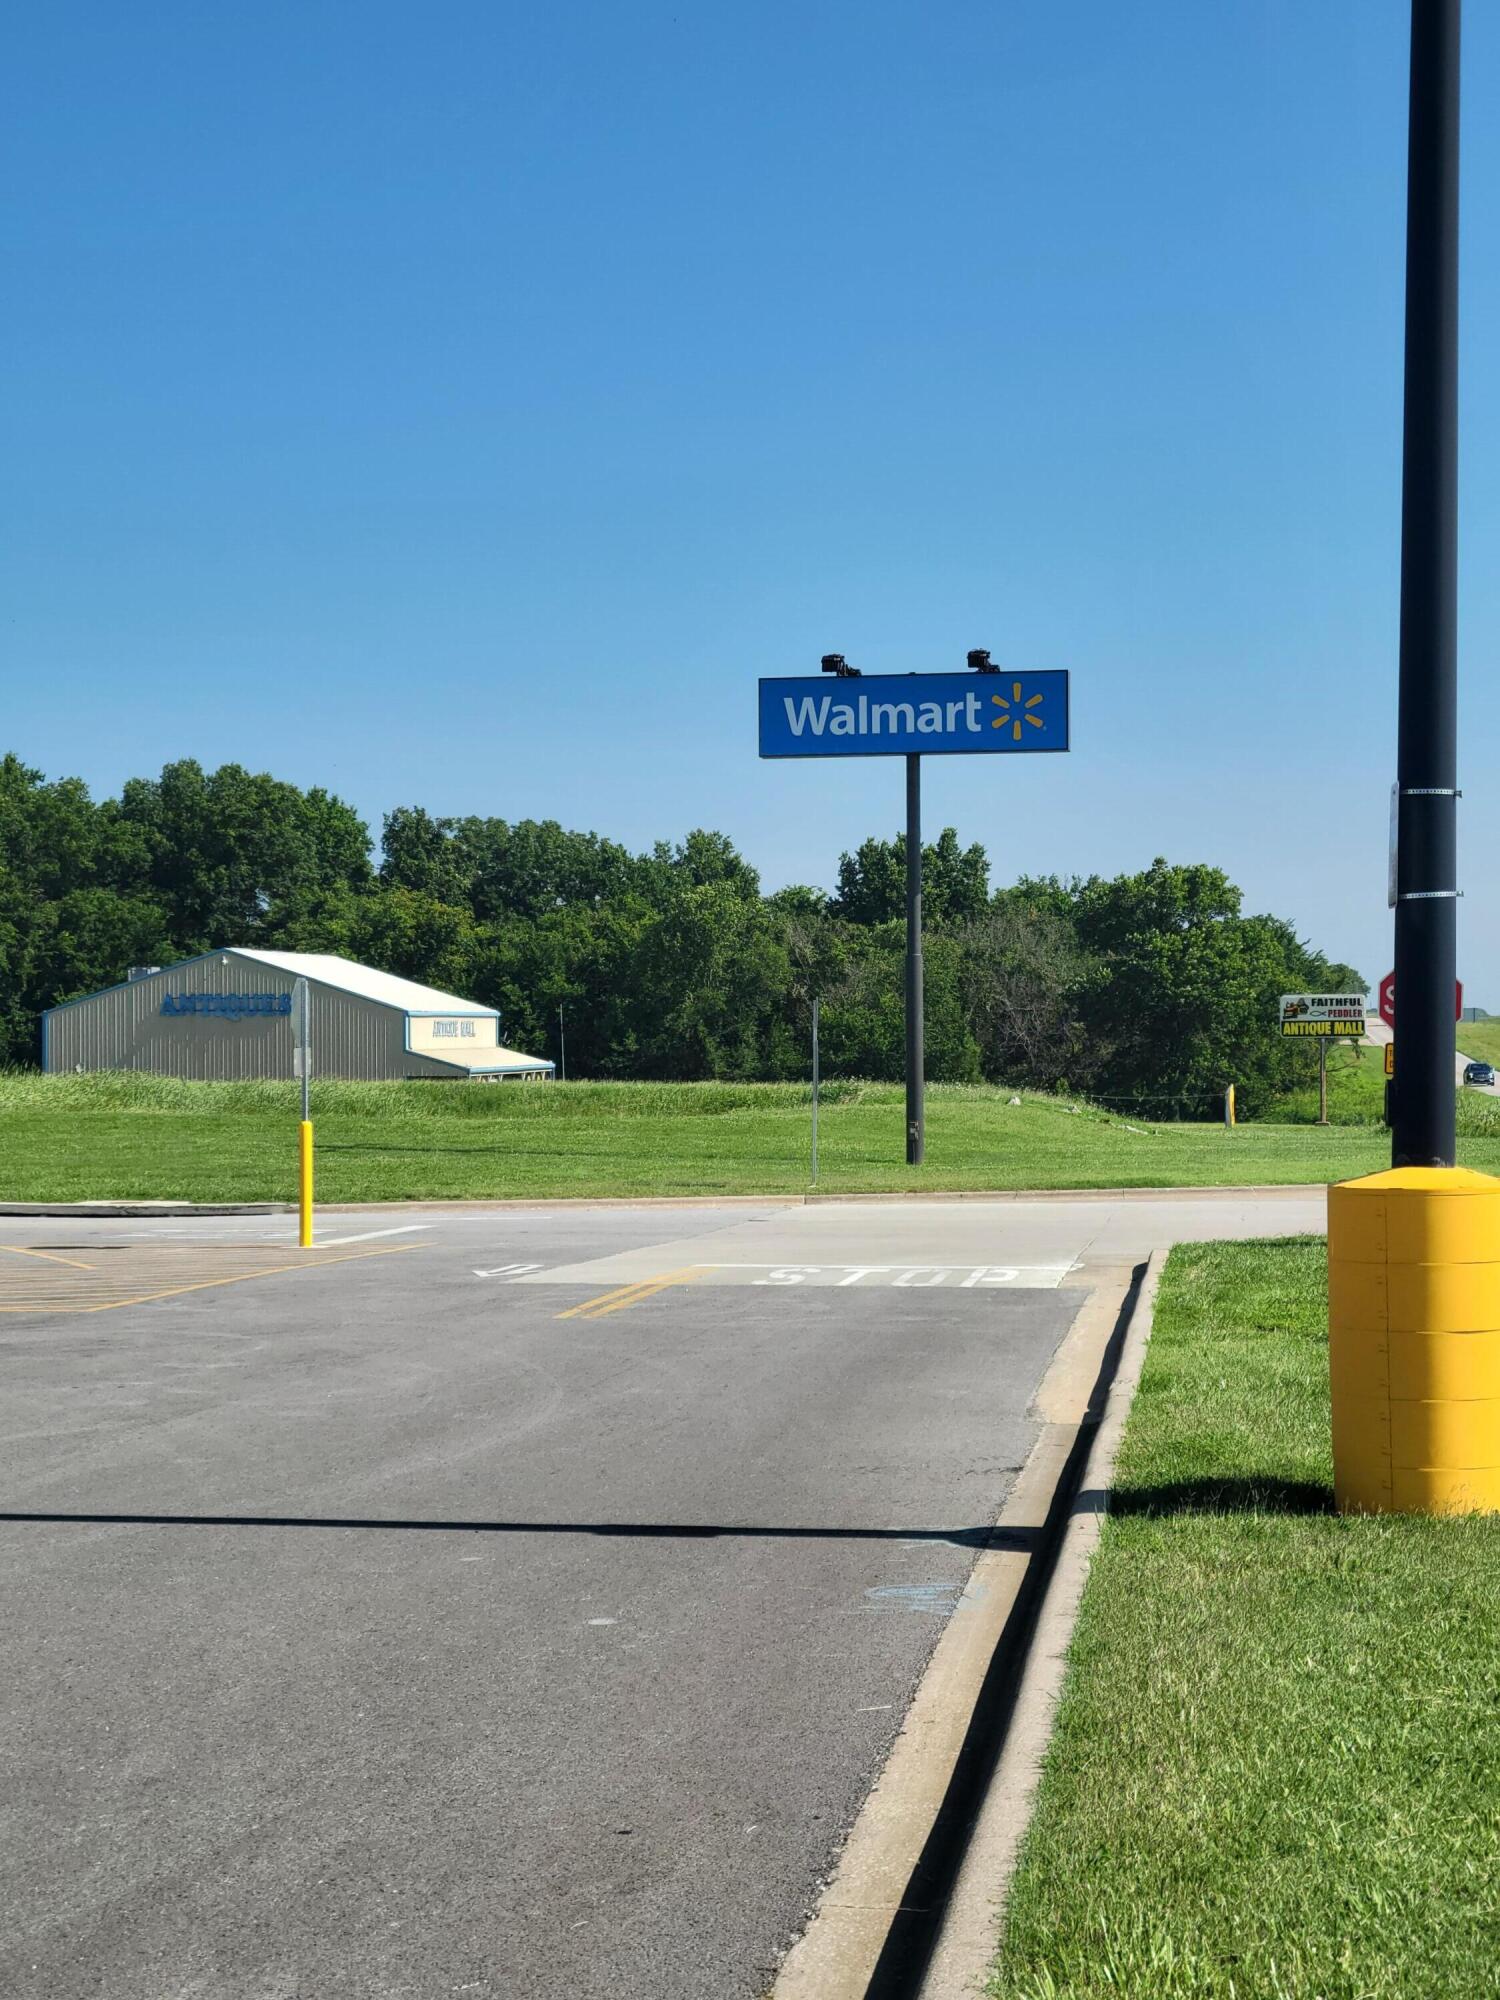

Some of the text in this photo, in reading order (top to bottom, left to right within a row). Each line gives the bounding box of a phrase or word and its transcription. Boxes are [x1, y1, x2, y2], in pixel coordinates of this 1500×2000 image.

[784, 692, 982, 736] Walmart
[1311, 998, 1362, 1007] FAITHFUL
[1327, 1009, 1362, 1018] PEDDLER
[1283, 1021, 1364, 1035] ANTIQUE MALL
[751, 1267, 1019, 1287] STOP
